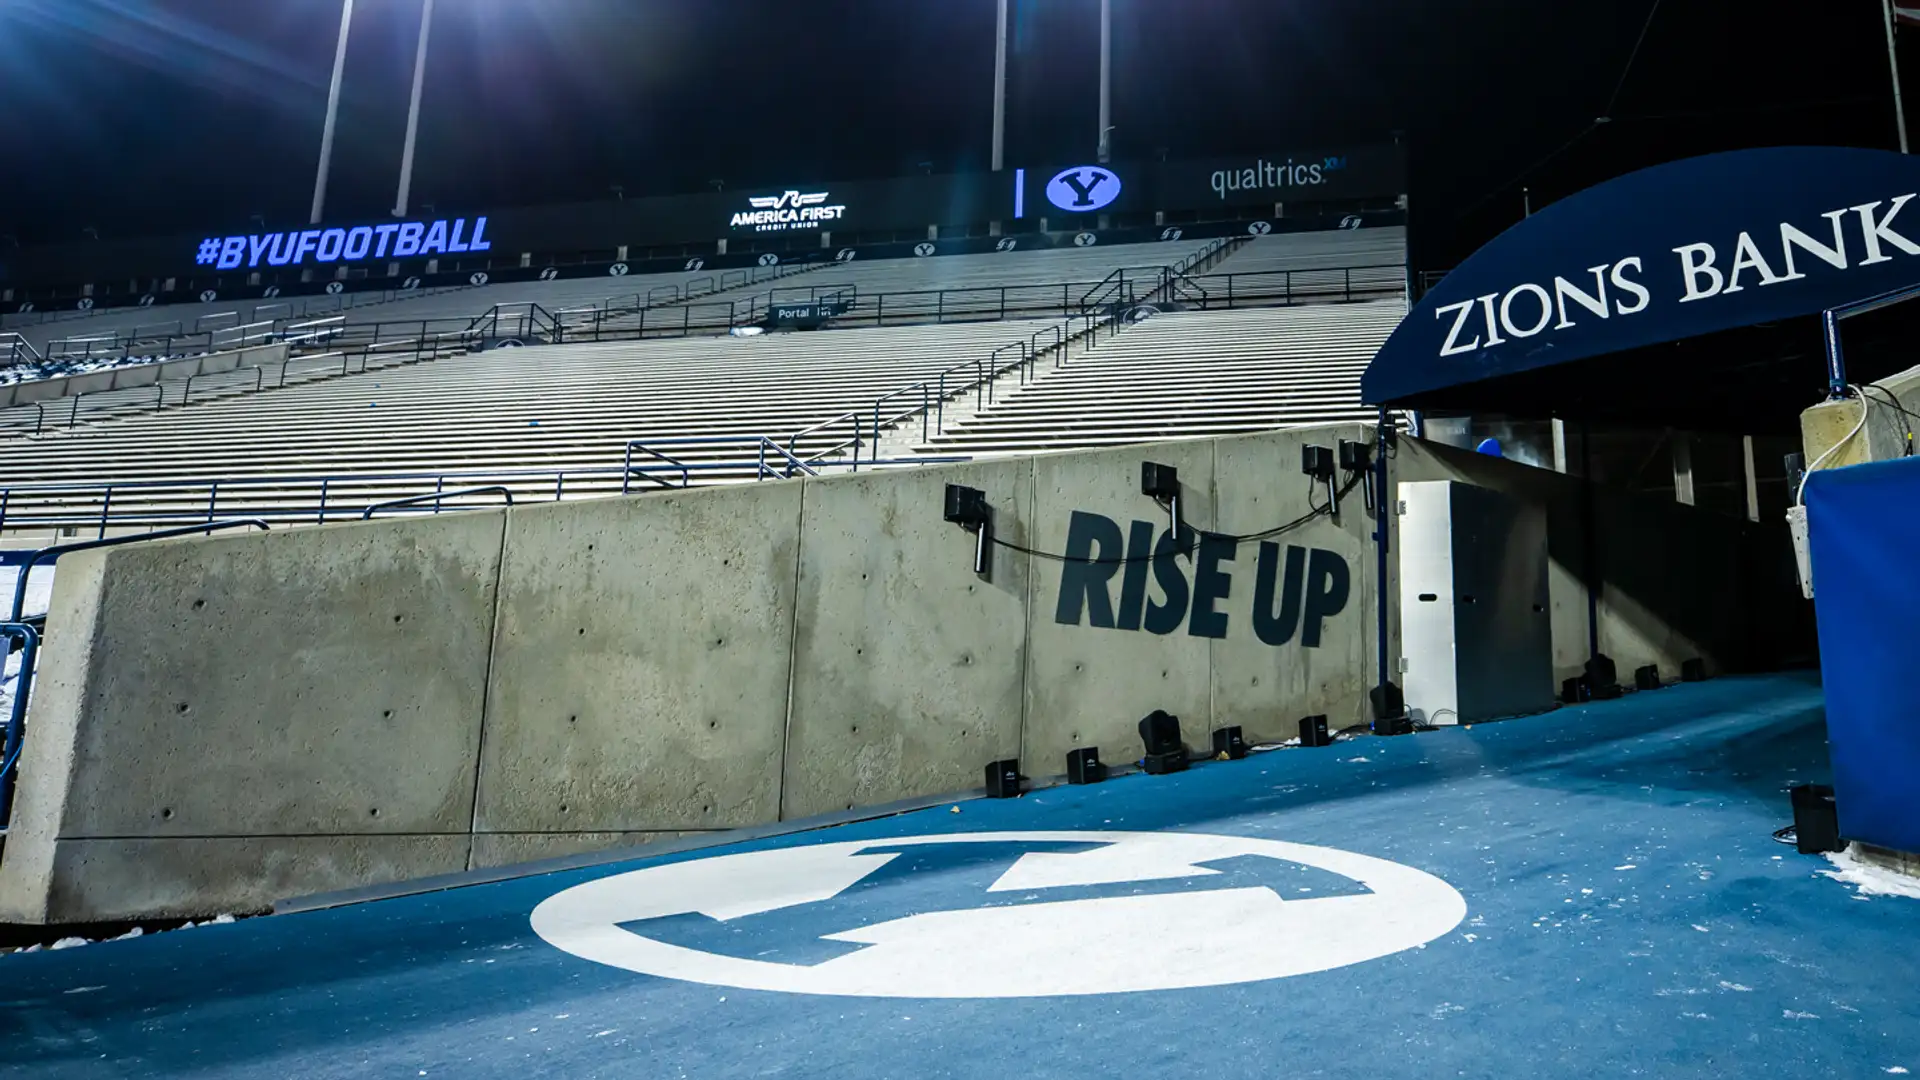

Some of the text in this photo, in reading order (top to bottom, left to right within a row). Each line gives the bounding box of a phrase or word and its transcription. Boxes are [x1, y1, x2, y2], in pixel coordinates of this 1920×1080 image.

[730, 205, 846, 226] AMERICA FIRST
[755, 221, 819, 232] CREDIT UNION
[196, 217, 491, 270] #BYUFOOTBALL
[1435, 193, 1920, 357] ZIONS BANK
[778, 307, 810, 318] Portal
[1055, 510, 1350, 648] RISE UP
